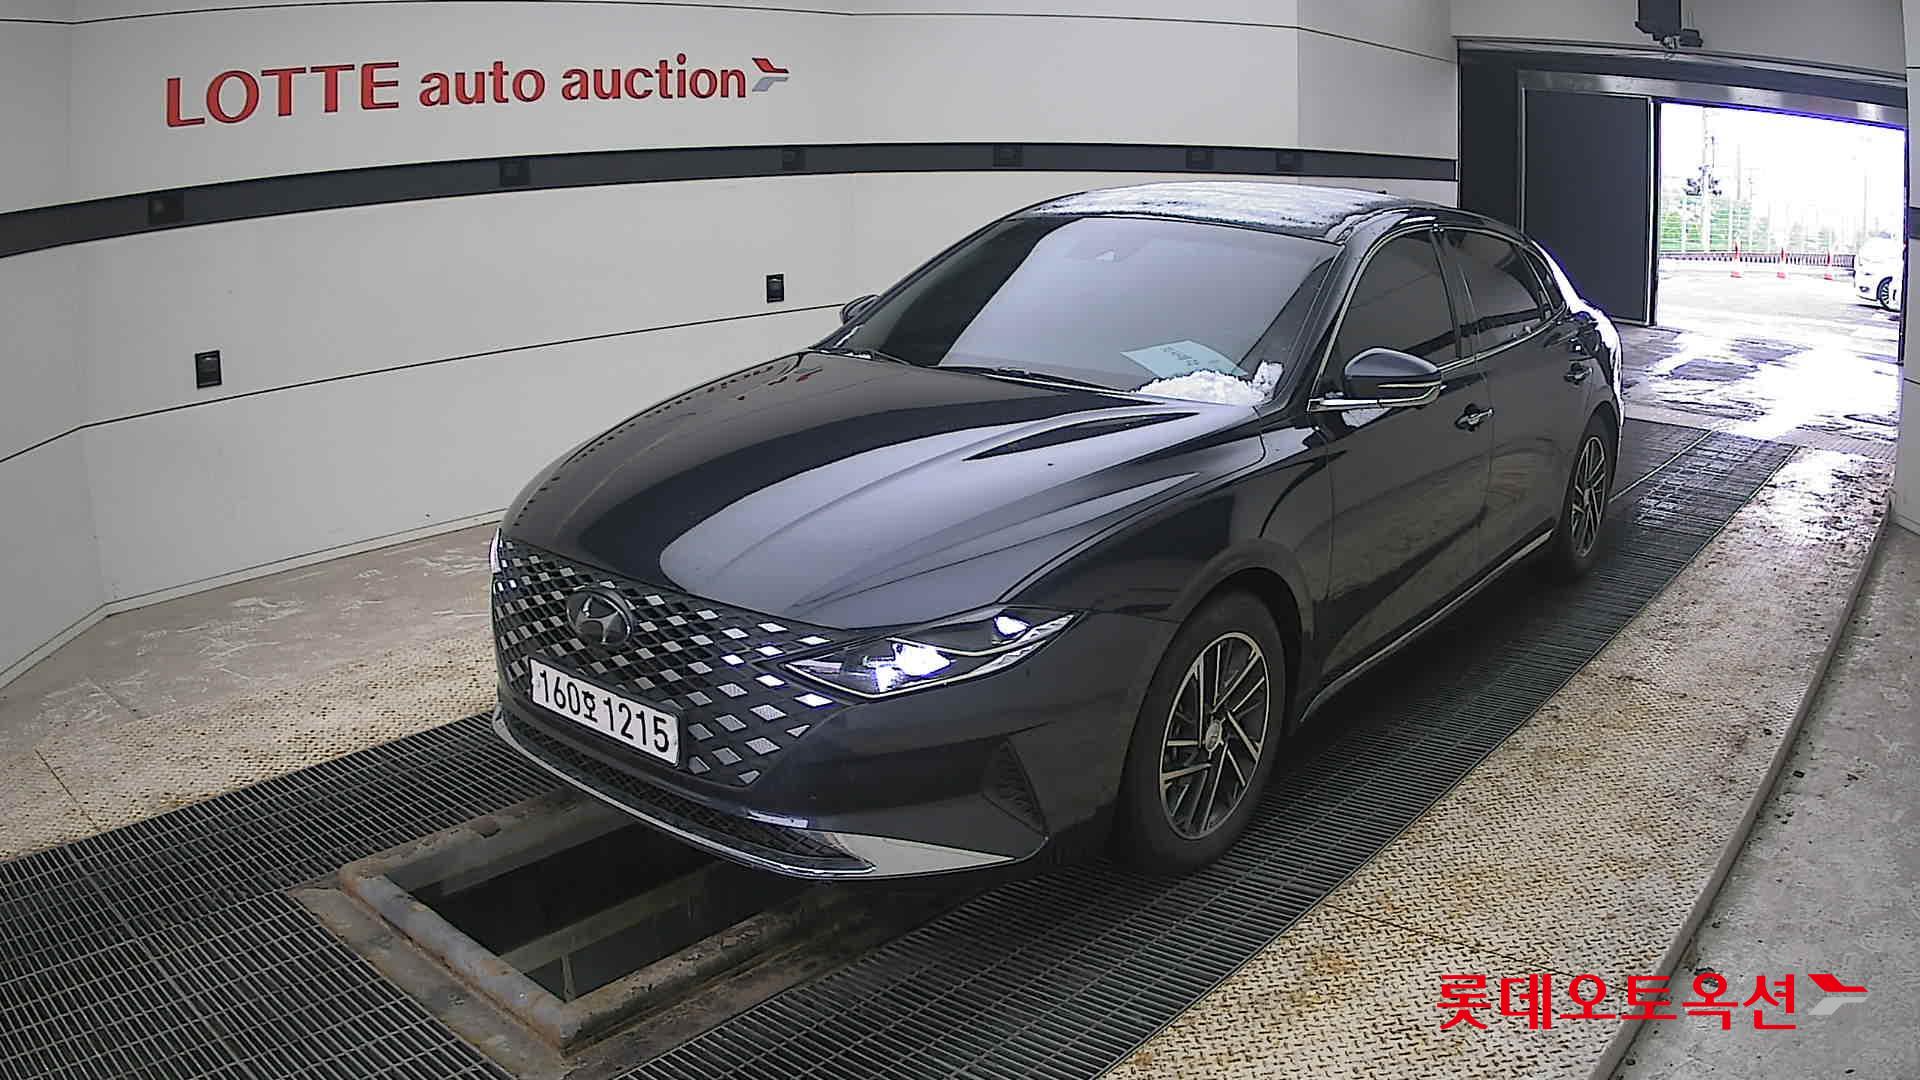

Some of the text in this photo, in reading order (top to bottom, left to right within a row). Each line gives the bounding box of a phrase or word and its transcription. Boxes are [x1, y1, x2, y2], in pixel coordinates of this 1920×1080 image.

[165, 53, 747, 127] LOTTE auto auction
